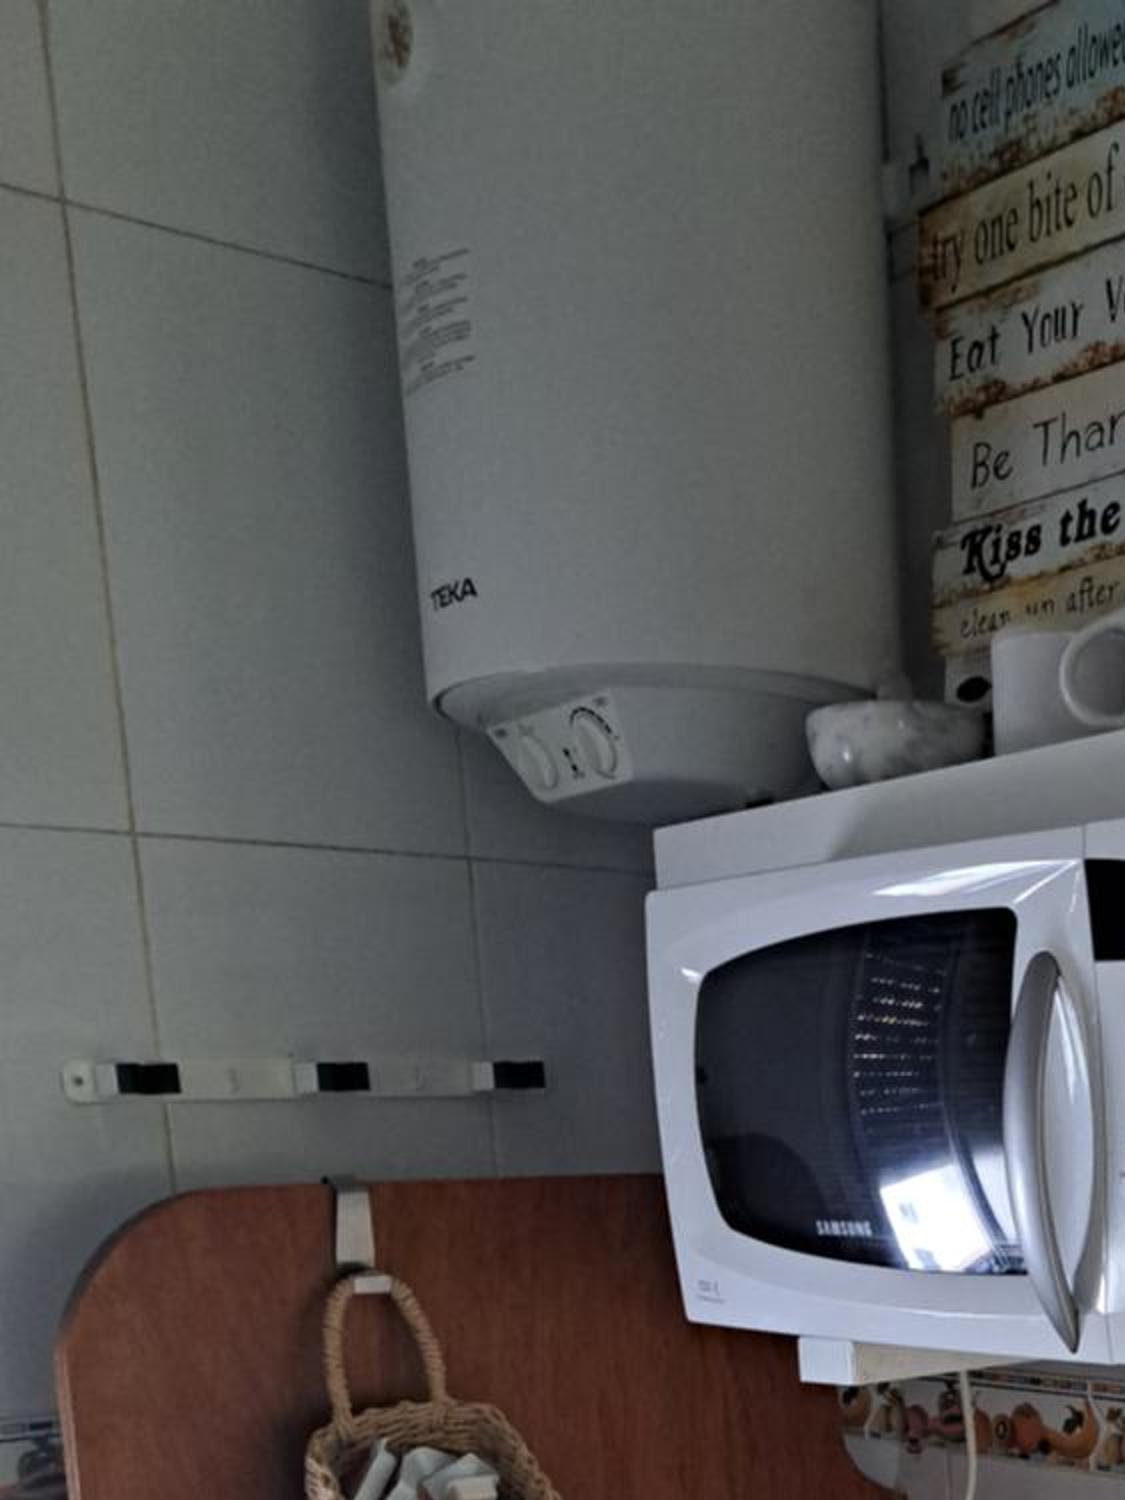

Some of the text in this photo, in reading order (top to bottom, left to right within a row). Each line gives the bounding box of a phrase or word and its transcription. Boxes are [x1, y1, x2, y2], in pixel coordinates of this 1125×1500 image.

[948, 98, 968, 143] no
[971, 66, 1001, 135] cell
[1005, 53, 1061, 132] phones
[931, 225, 963, 293] try
[973, 207, 1019, 266] one
[1027, 170, 1078, 244] bite
[1087, 142, 1120, 219] of
[948, 325, 1000, 382] Eat
[1020, 301, 1085, 354] Your
[969, 441, 1014, 490] Be
[960, 522, 1042, 584] Kiss
[1058, 499, 1122, 548] the
[430, 577, 479, 611] TEKA
[1066, 576, 1121, 617] after
[815, 1219, 874, 1237] SAMSUNG
